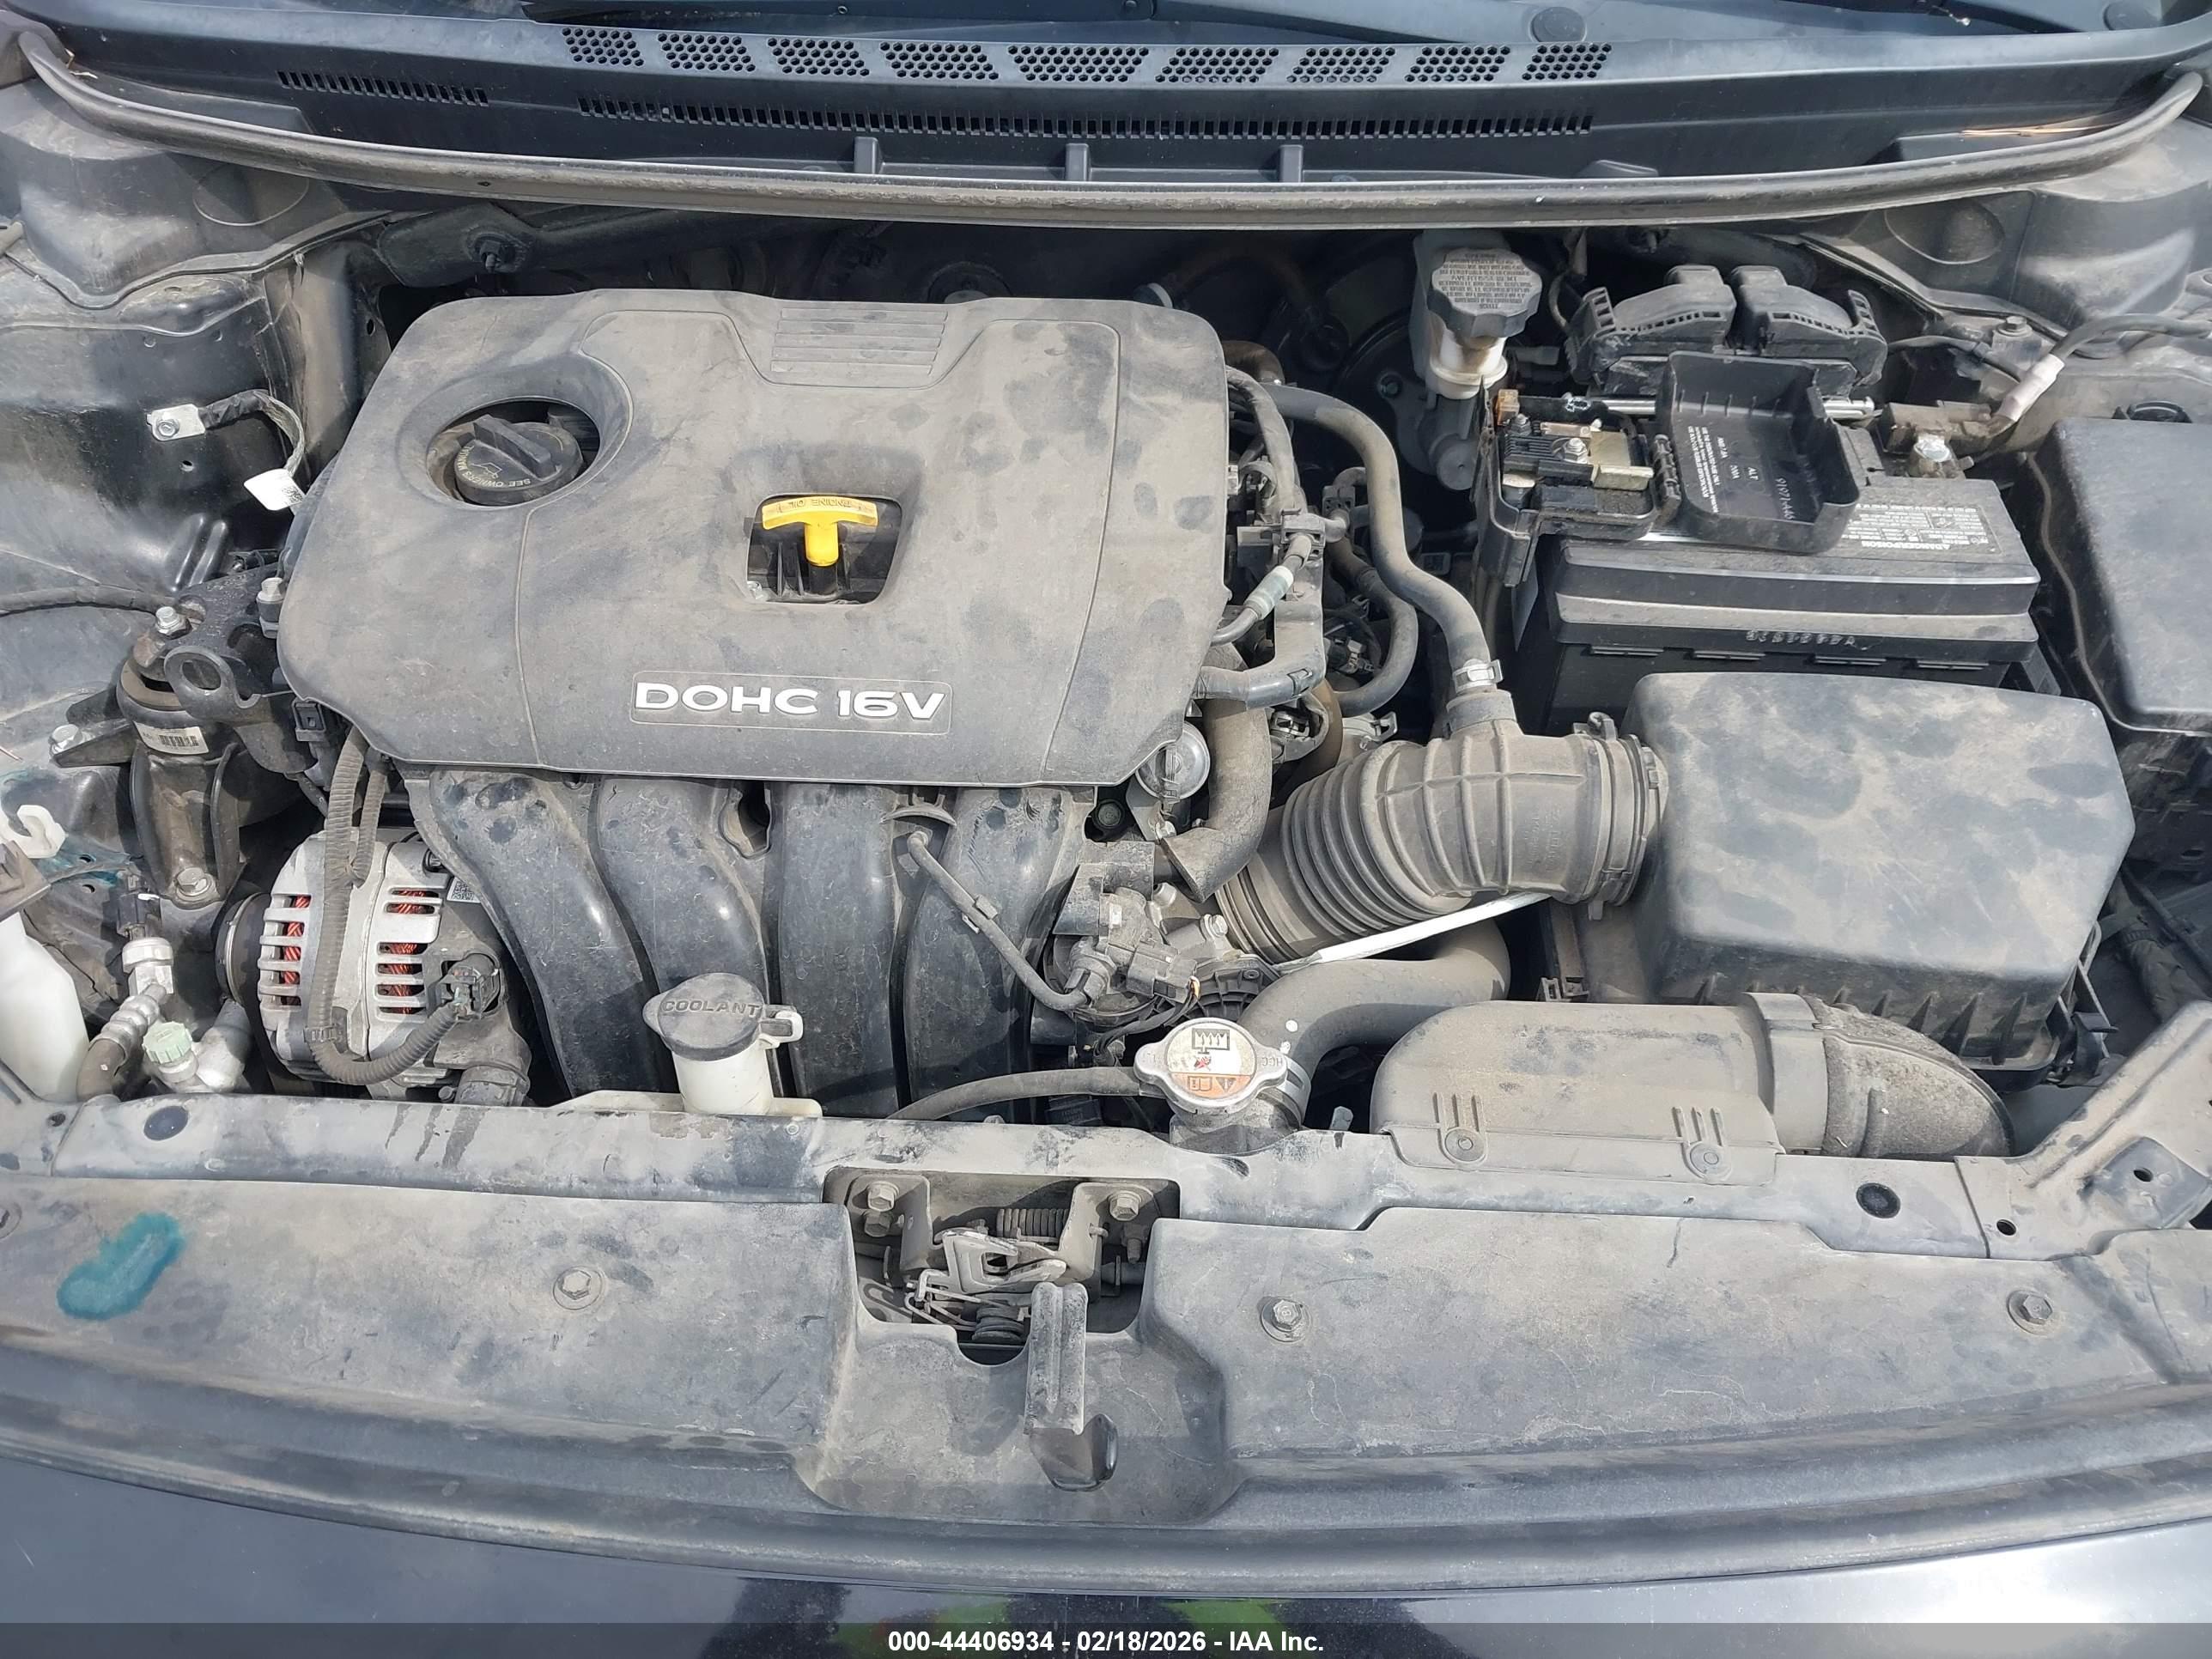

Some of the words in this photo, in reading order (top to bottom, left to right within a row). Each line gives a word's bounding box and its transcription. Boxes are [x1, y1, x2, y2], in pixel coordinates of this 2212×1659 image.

[1748, 467, 1758, 480] ALT
[508, 478, 531, 487] SEE
[787, 499, 805, 507] OIL
[635, 682, 817, 715] DOHC
[837, 690, 945, 720] 16V
[661, 1000, 762, 1017] COOLANT
